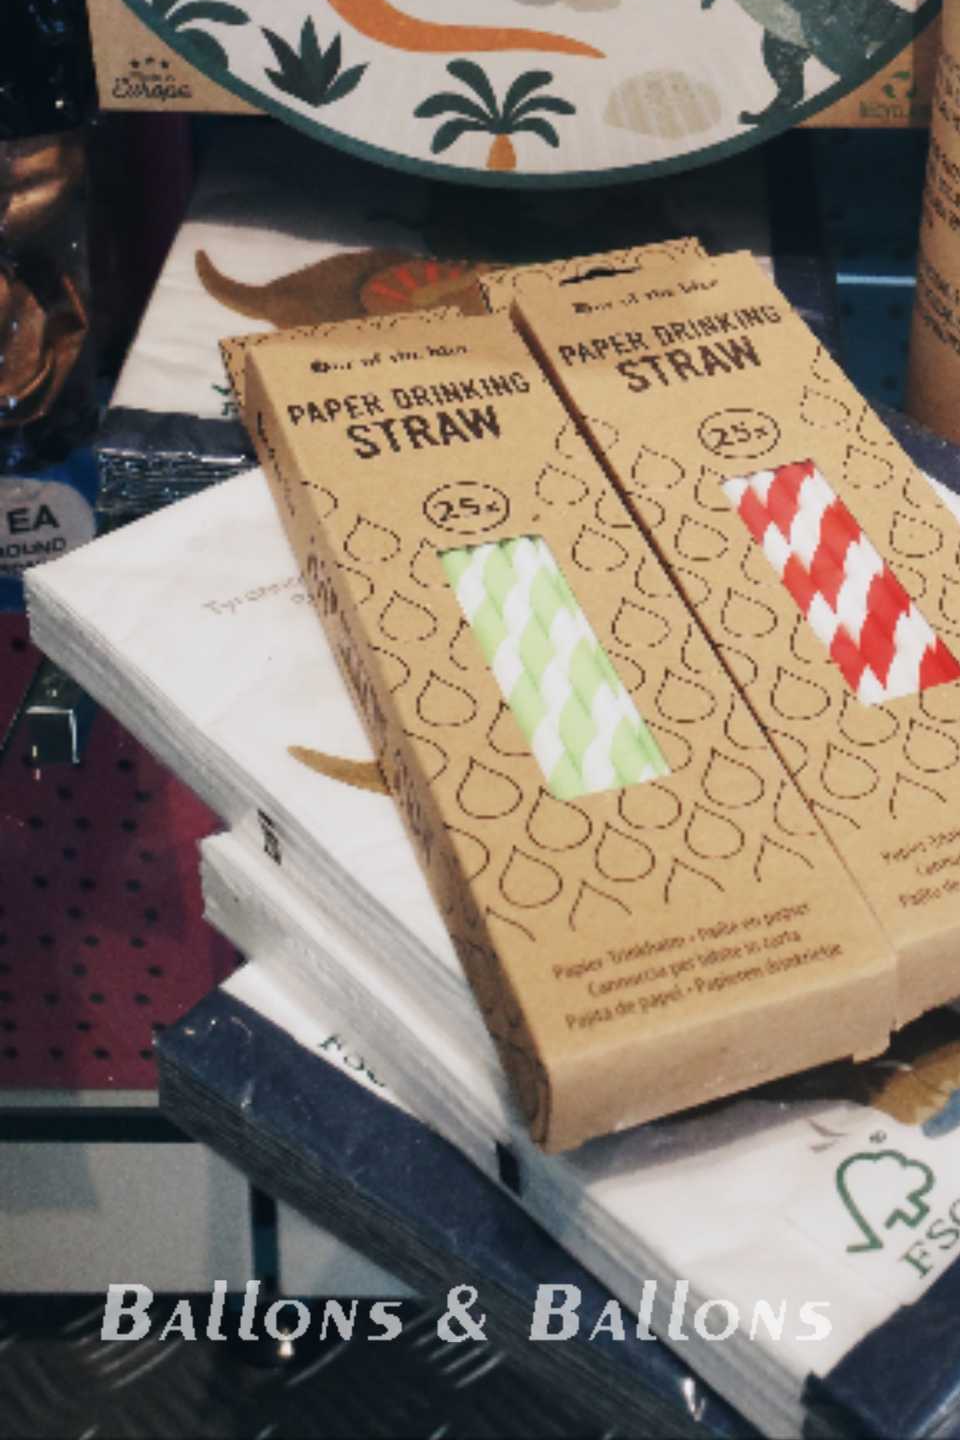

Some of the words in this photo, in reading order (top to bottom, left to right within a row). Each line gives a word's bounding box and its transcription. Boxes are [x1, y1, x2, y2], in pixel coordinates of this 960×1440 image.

[558, 330, 649, 367] PAPER
[651, 305, 782, 347] DRINKING
[614, 334, 763, 394] STRAW
[286, 393, 385, 426] PAPER
[390, 370, 531, 410] DRINKING
[345, 404, 502, 460] STRAW
